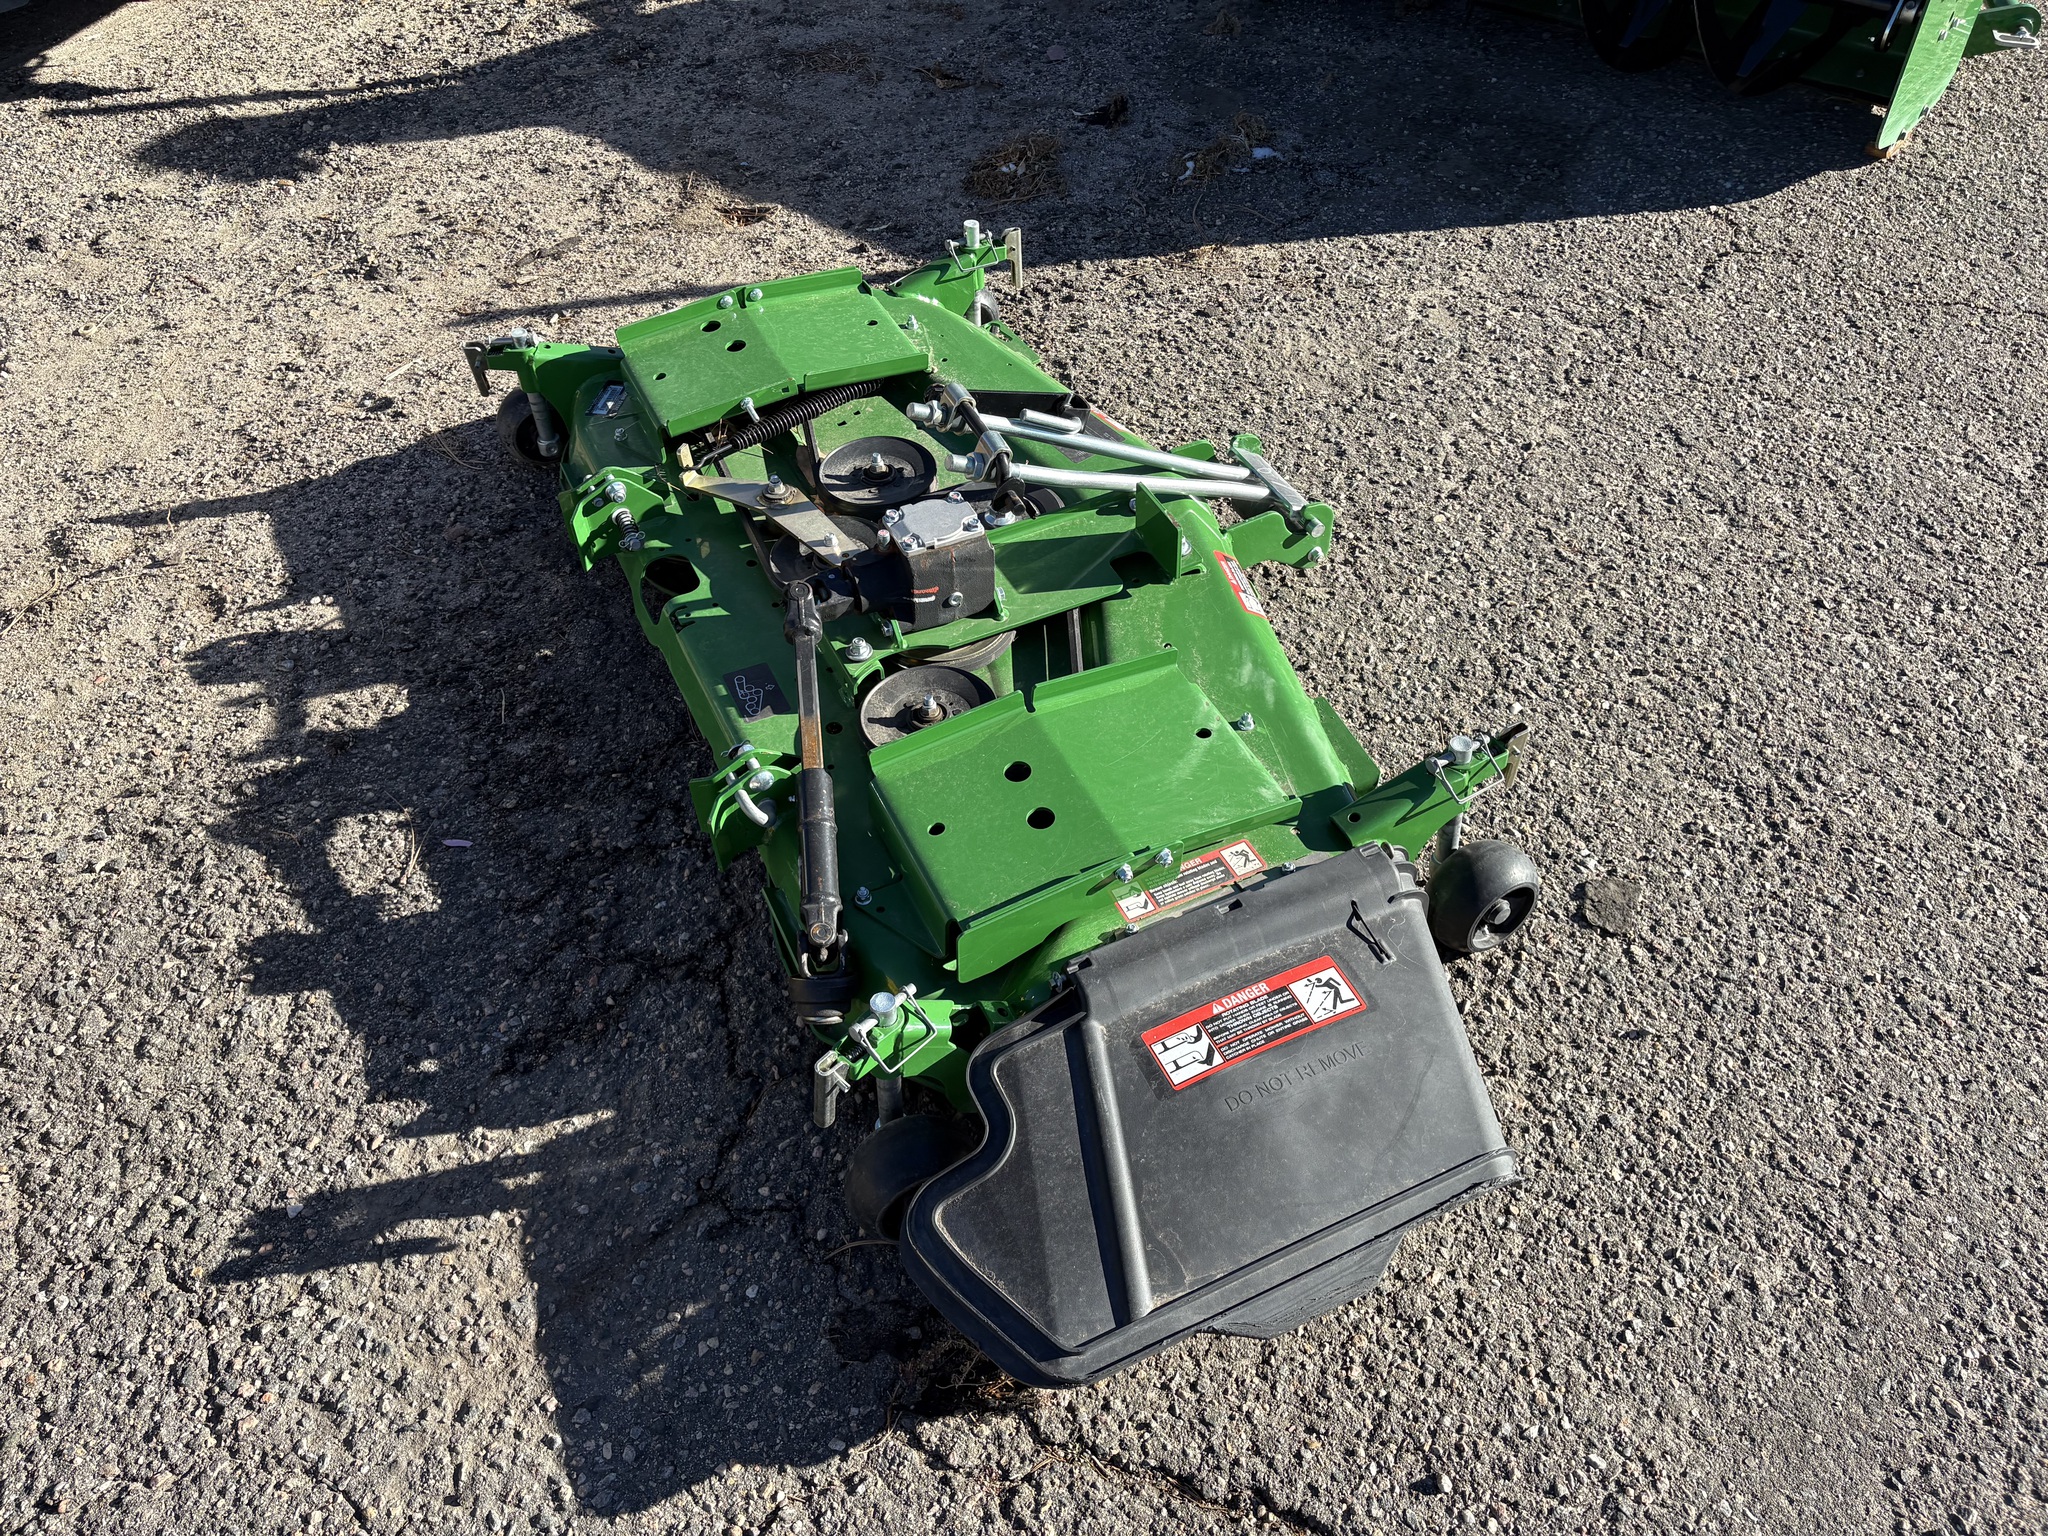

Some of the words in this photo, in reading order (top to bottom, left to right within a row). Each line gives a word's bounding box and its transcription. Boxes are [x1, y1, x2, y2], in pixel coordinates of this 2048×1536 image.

[1180, 858, 1203, 871] NGER
[1222, 1003, 1250, 1017] ROTATING
[1250, 995, 1269, 1005] BLADE
[1223, 983, 1270, 1008] DANGER
[1227, 1016, 1253, 1029] THROWN
[1252, 1005, 1279, 1018] OBJECTS
[1223, 1042, 1250, 1055] DISCHARGE
[1226, 1049, 1246, 1059] CATCHER
[1251, 1040, 1266, 1048] PLACE
[1224, 1090, 1253, 1111] DO
[1255, 1073, 1293, 1097] NOT
[1295, 1041, 1370, 1080] REMOVE
